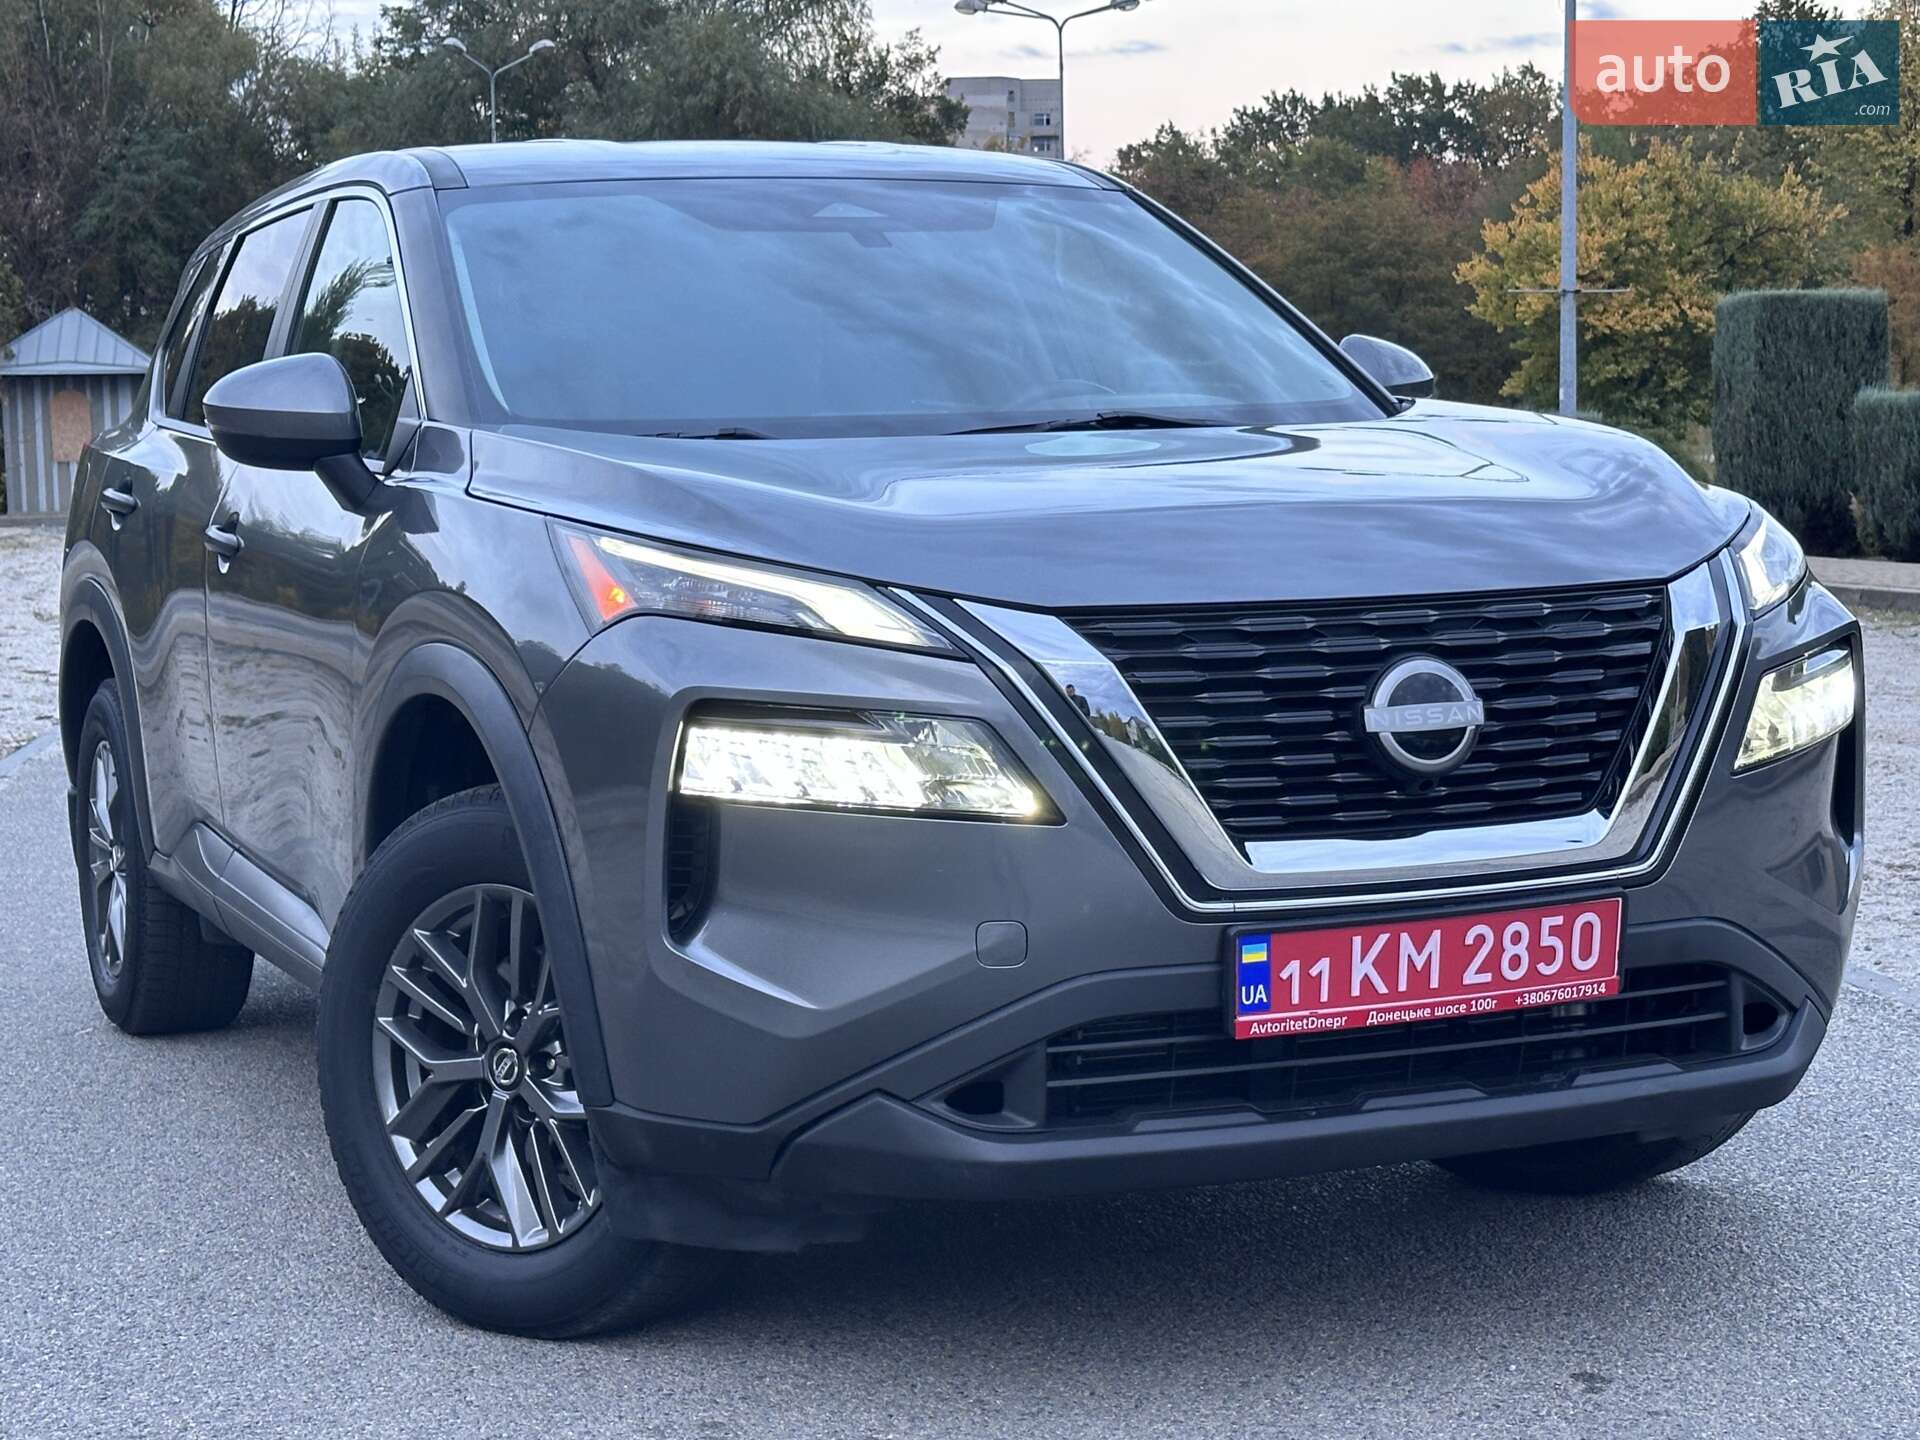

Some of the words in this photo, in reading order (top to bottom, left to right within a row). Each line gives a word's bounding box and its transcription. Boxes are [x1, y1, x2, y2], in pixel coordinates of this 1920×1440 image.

[1369, 705, 1482, 728] NISSAN
[1279, 957, 1330, 1005] 11
[1462, 912, 1602, 987] 2850
[1241, 984, 1268, 1005] UA
[1515, 982, 1606, 1006] +380676017914
[1366, 1006, 1432, 1026] Донецьке
[1434, 1003, 1467, 1016] шосе
[1470, 998, 1498, 1012] 100г
[1250, 1015, 1348, 1035] AvtoritetDnepr
